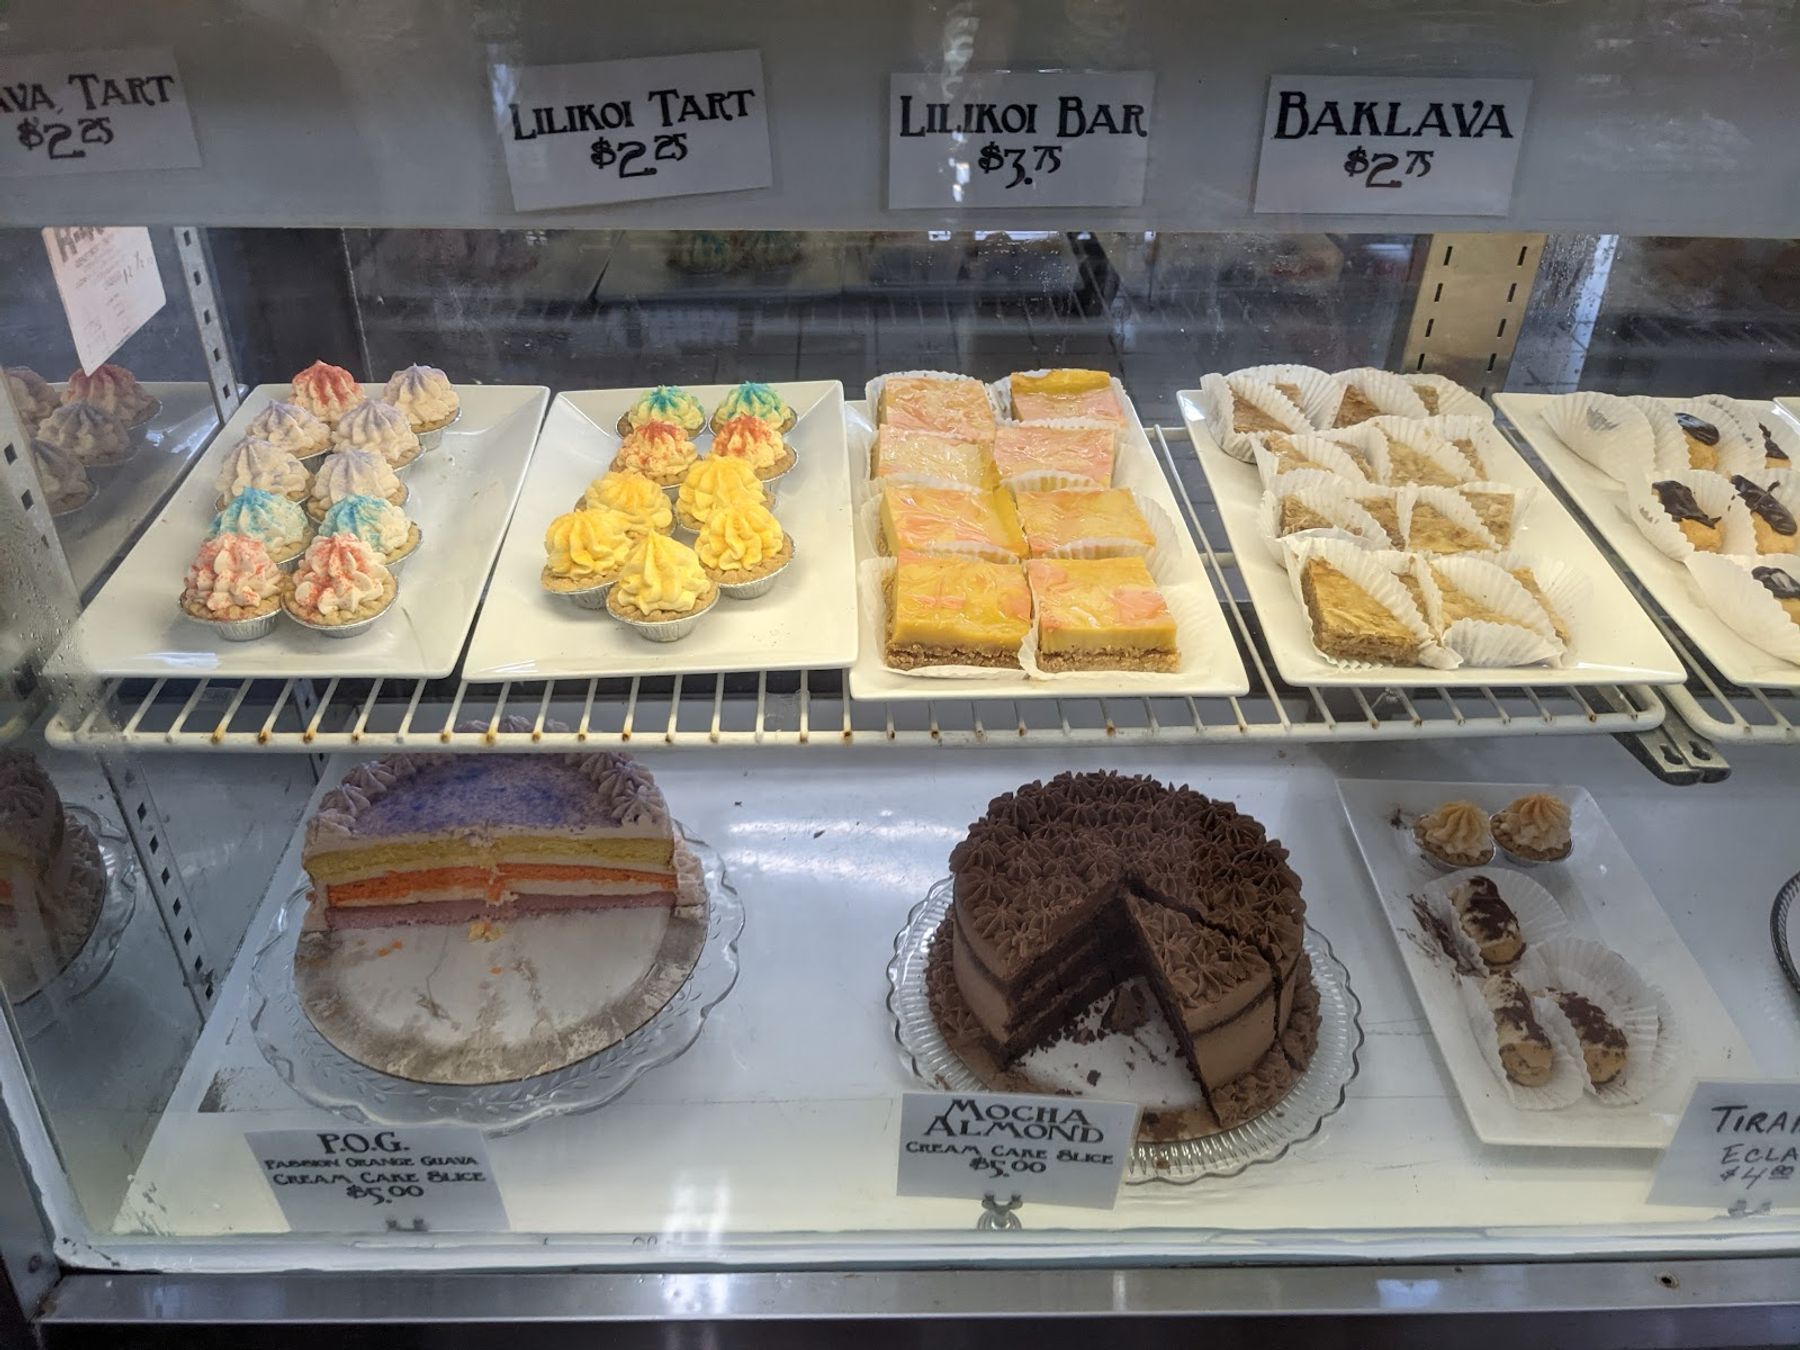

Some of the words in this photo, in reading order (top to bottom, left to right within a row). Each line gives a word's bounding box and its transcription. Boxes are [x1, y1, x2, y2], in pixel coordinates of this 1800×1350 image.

[68, 74, 175, 110] TART
[509, 101, 634, 140] LILIKOI
[648, 89, 755, 127] TART
[900, 95, 1038, 137] LILIKOI
[1057, 96, 1148, 138] BAR
[1274, 91, 1514, 139] BAKLAVA
[978, 141, 1063, 189] $3.75
[947, 1099, 1092, 1126] MOCHA
[923, 1115, 1104, 1144] ALMOND
[316, 1131, 411, 1154] P.O.G.
[905, 1141, 980, 1155] CREAM
[991, 1144, 1048, 1160] CAKE
[1056, 1149, 1114, 1165] SLICE
[1720, 1143, 1799, 1165] ECLA
[345, 1156, 415, 1167] ORANGE
[420, 1155, 478, 1167] GUAVA
[969, 1156, 1047, 1178] $5.00
[273, 1173, 352, 1185] CREAM
[360, 1171, 419, 1184] CAKE
[427, 1170, 486, 1183] SLICE
[346, 1185, 425, 1206] $5.00
